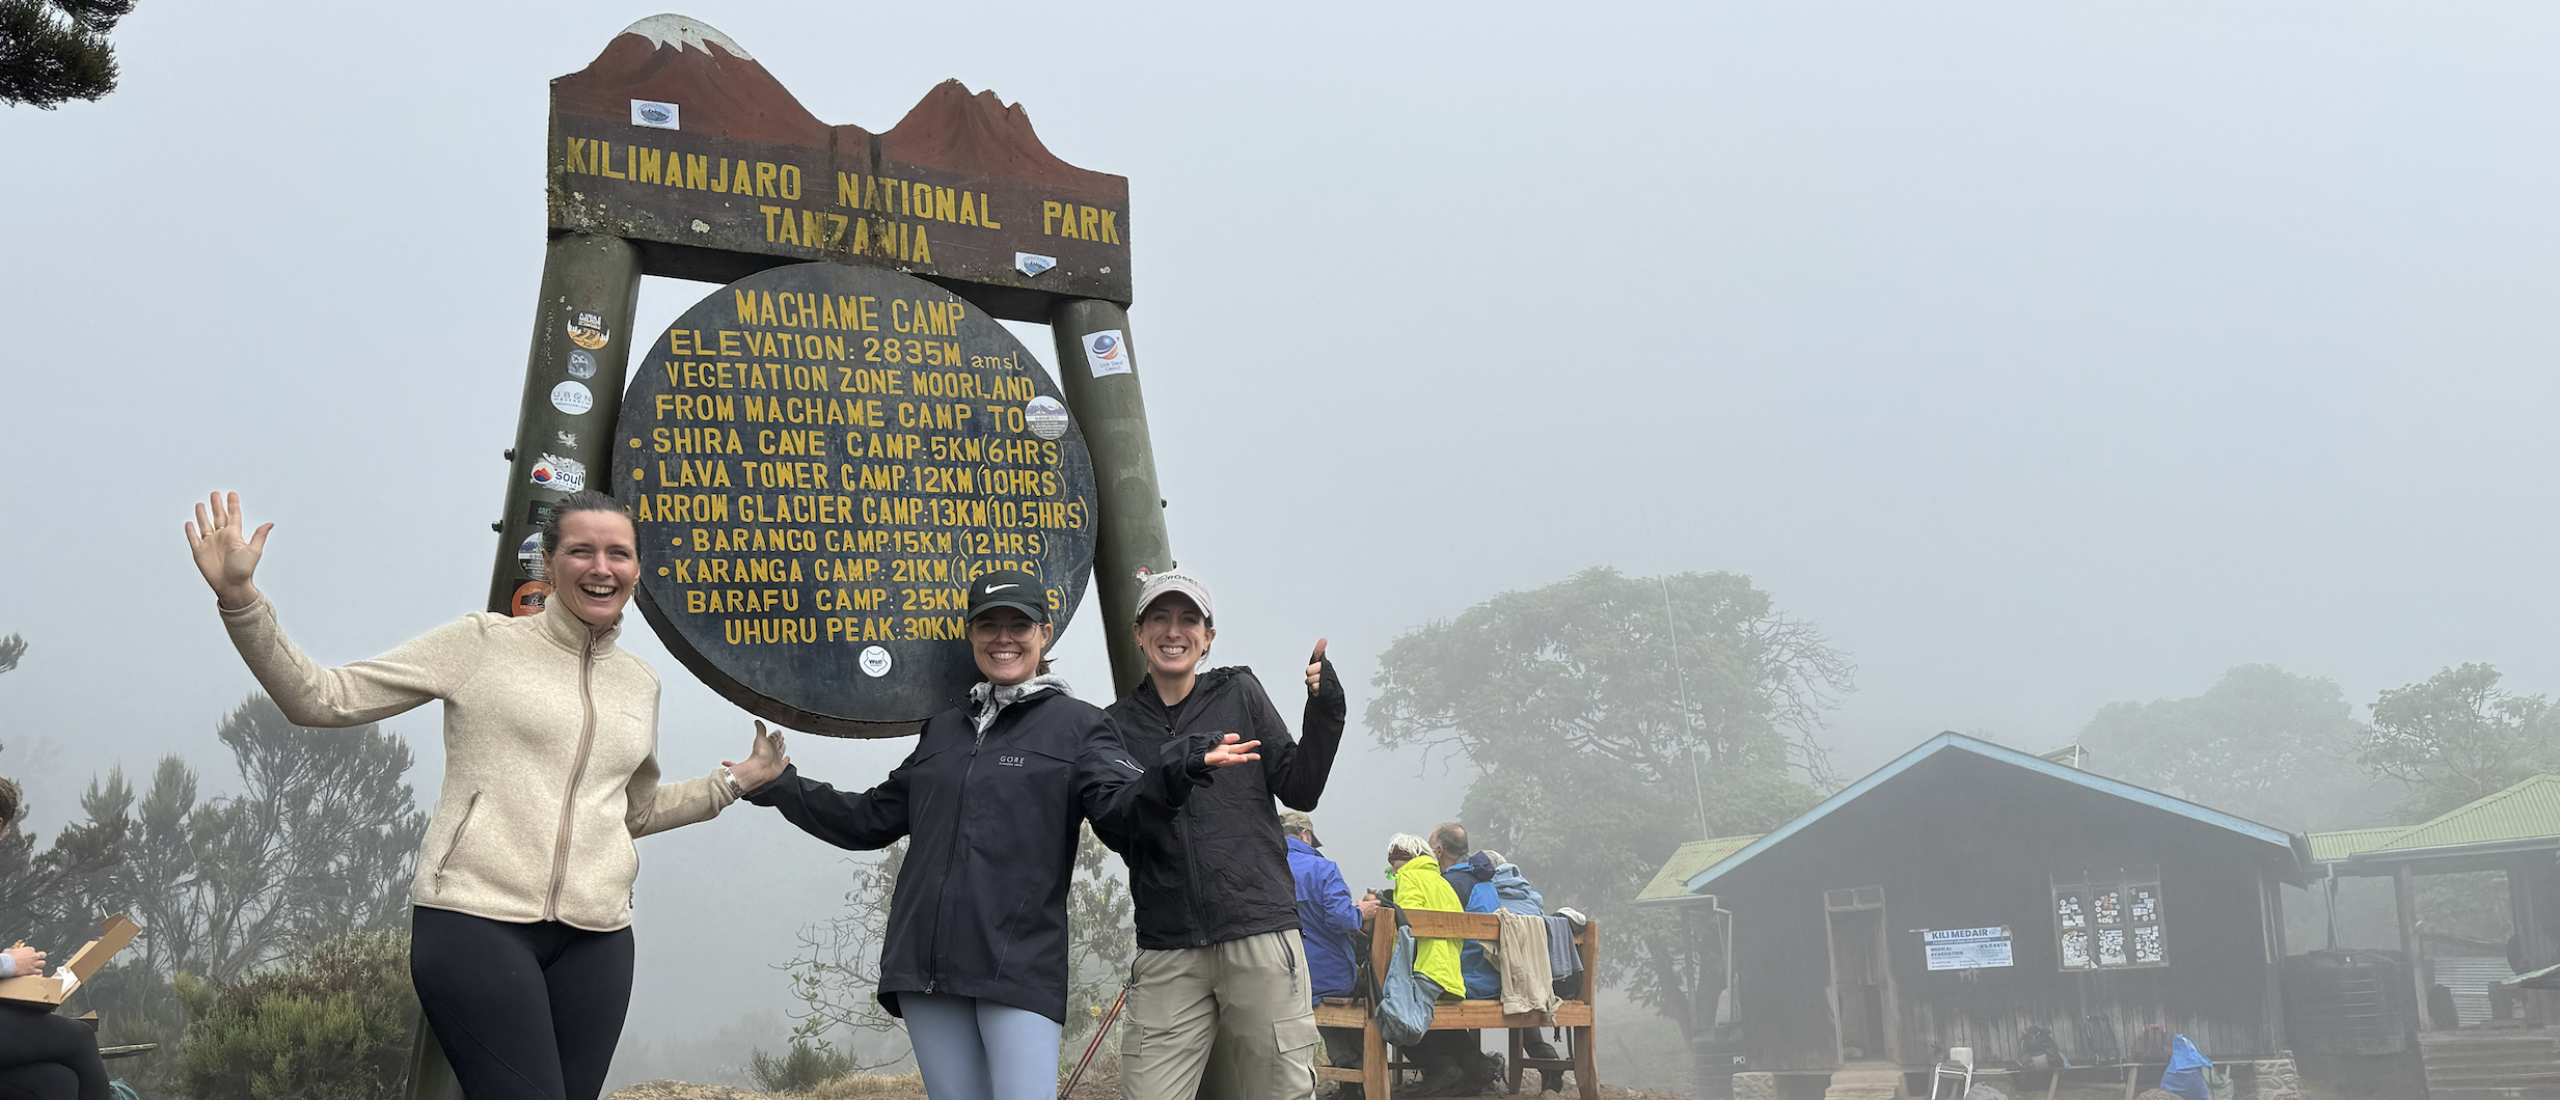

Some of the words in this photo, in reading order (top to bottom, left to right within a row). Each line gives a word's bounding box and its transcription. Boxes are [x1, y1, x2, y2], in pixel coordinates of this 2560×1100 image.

[566, 136, 805, 201] KILIMANJARO
[837, 171, 1002, 230] NATIONAL
[1042, 200, 1121, 246] PARK
[759, 204, 932, 265] TANZANIA
[734, 288, 880, 332] MACHAME
[891, 298, 966, 337] CAMP
[670, 328, 855, 362] ELEVATION:
[863, 337, 963, 367] 2835M
[971, 350, 1020, 370] amsl
[665, 361, 829, 392] VEGETATION
[837, 366, 904, 396] ZONE
[911, 370, 1036, 402] MOORLAND
[655, 394, 735, 422] FROM
[744, 395, 885, 428] MACHAME
[898, 401, 972, 431] CAMP
[652, 427, 744, 455] SHIRA
[758, 429, 827, 457] CAVE
[555, 471, 581, 486] soul
[658, 459, 732, 488] LAVA
[741, 460, 829, 490] TOWER
[638, 493, 729, 523] ARROW
[737, 494, 854, 524] GLACIER
[692, 528, 818, 553] BARANCO
[674, 557, 804, 584] KARANGA
[814, 558, 886, 583] CAMP:
[686, 588, 799, 614] BARAFU
[815, 588, 894, 612] CAMP:
[901, 587, 969, 611] 25KM
[724, 617, 818, 646] UHURU
[1000, 755, 1025, 764] GORE
